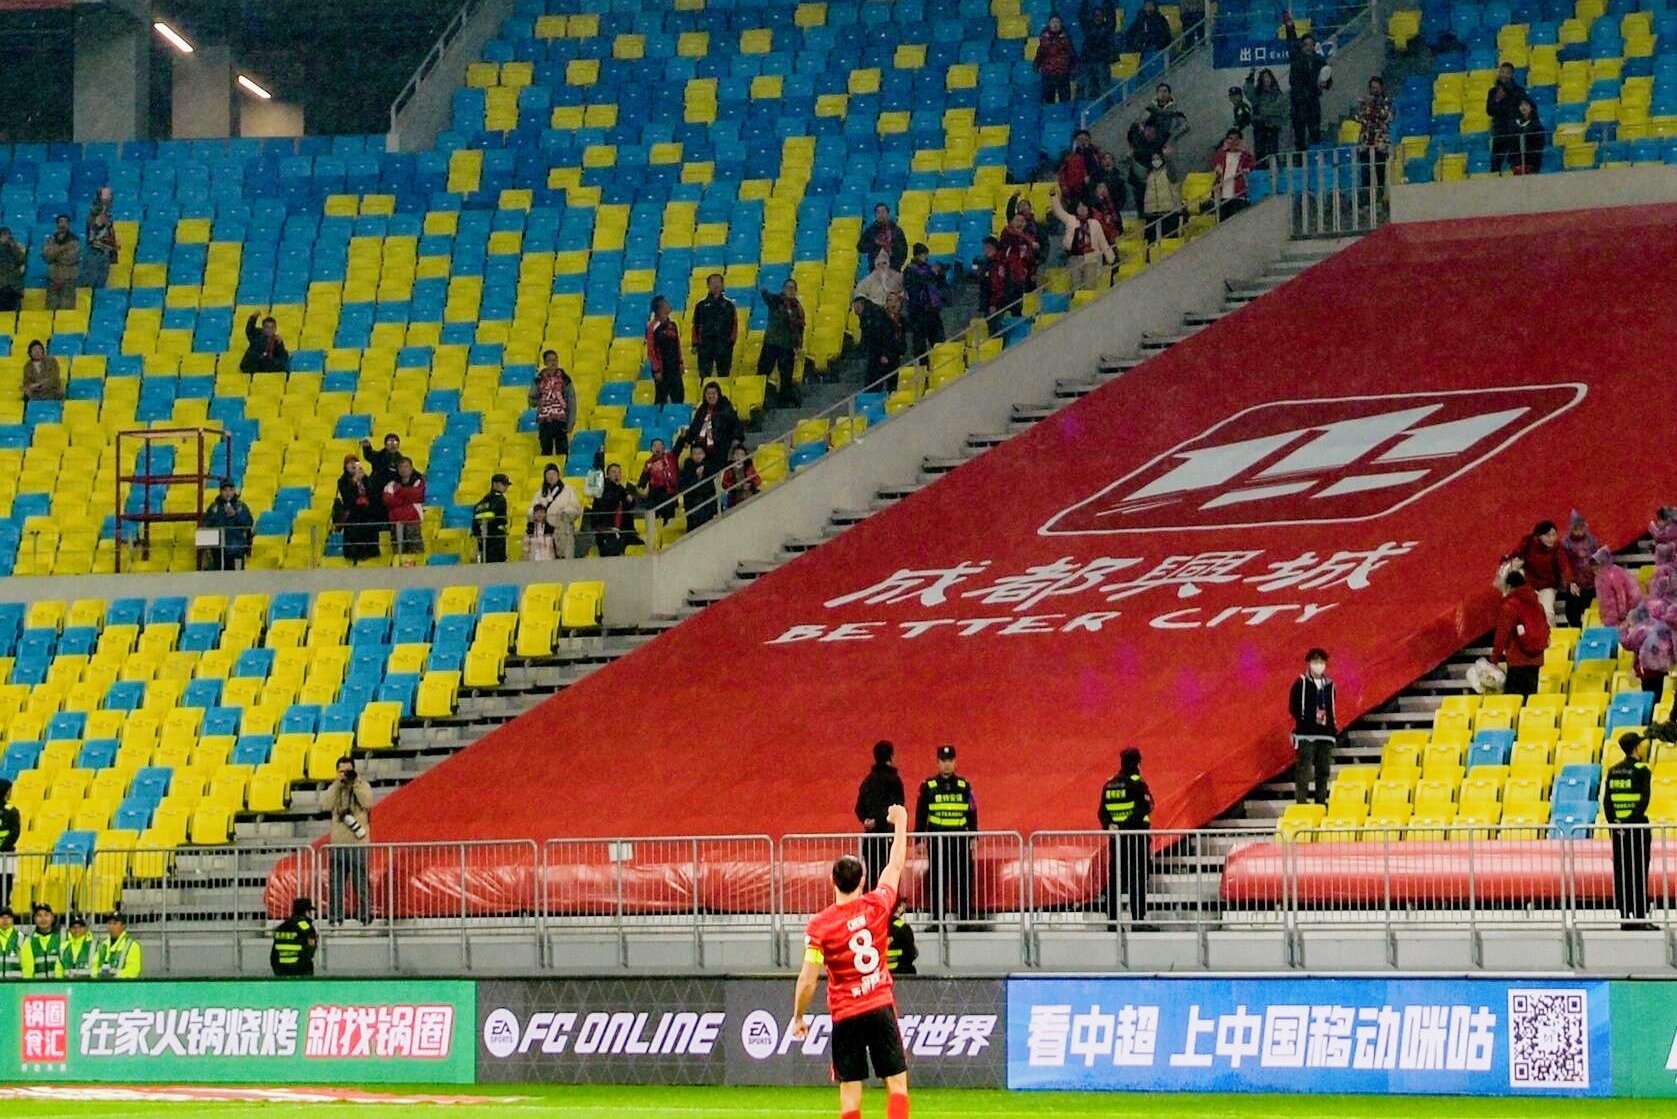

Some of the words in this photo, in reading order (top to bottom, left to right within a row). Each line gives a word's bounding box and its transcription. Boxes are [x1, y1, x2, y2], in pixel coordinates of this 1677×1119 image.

[1239, 46, 1266, 61] 出口
[765, 610, 1122, 644] BETTER
[1149, 603, 1340, 630] CITY
[848, 928, 880, 974] 8
[25, 1000, 65, 1027] 锅圈
[80, 1007, 299, 1056] 在家火锅烧烤
[305, 1004, 454, 1058] 就找锅圈
[492, 1020, 512, 1034] EA
[518, 1012, 575, 1054] FC
[575, 1012, 726, 1055] ONLINE
[750, 1021, 771, 1036] EA
[777, 1013, 833, 1055] FC
[25, 1029, 65, 1057] 食汇
[1028, 1004, 1161, 1066] 看中超
[1168, 1004, 1497, 1071] 上中国移动咪咕
